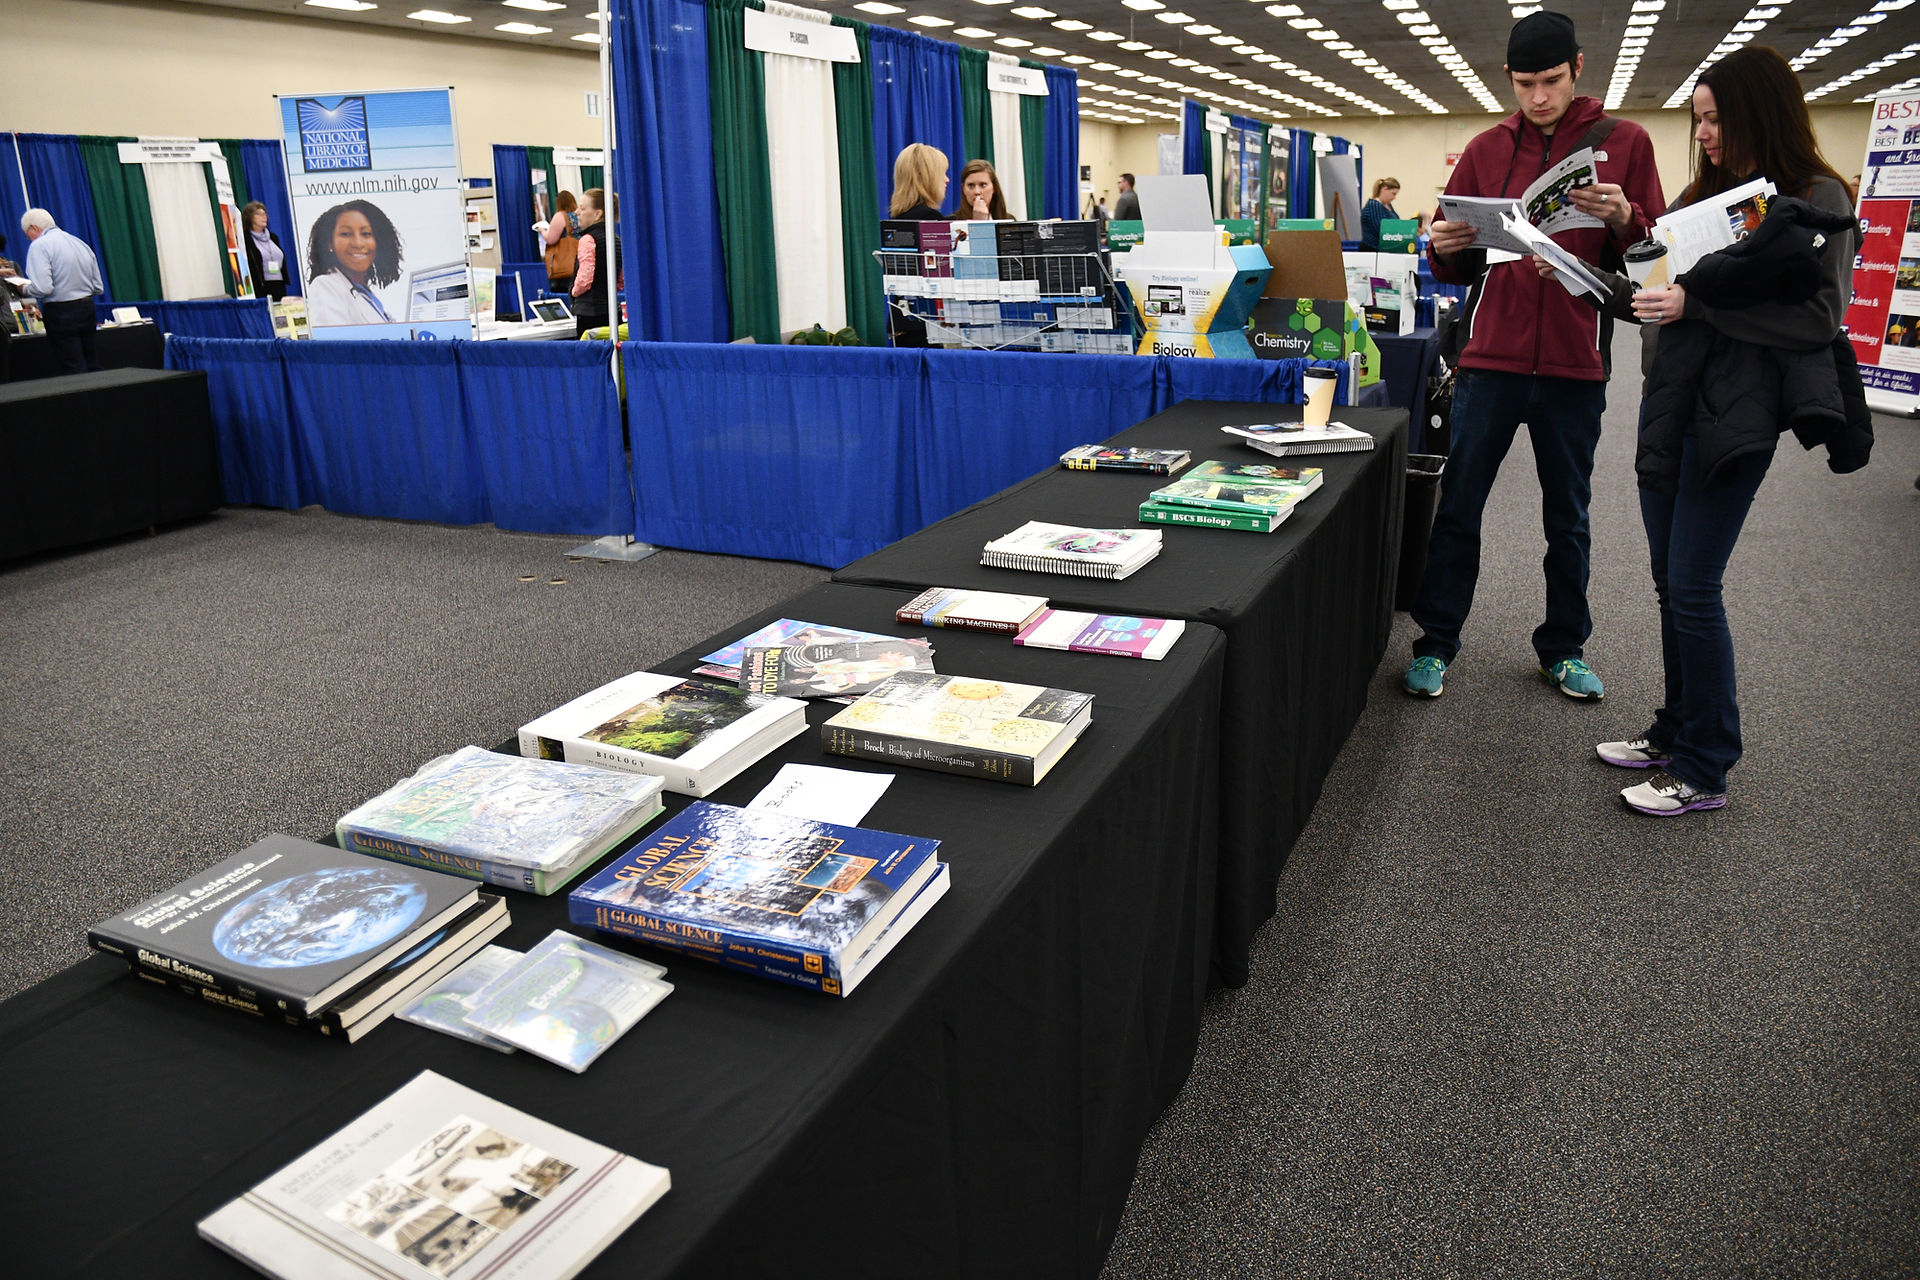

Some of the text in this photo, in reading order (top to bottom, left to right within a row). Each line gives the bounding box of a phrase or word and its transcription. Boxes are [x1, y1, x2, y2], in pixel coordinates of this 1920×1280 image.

[586, 94, 599, 116] H
[306, 131, 363, 144] NATIONAL
[1874, 138, 1896, 147] BEST
[305, 144, 366, 157] LIBRARY OF
[1885, 151, 1903, 163] and
[309, 157, 367, 170] MEDICINE
[305, 174, 439, 195] www.nlm.nih.gov
[1860, 219, 1891, 236] Boosting
[1853, 255, 1897, 273] Engineering,
[1188, 288, 1211, 296] realize
[1153, 342, 1197, 358] Biology
[1254, 332, 1311, 353] Chemistry
[1172, 513, 1195, 522] BSCS
[1197, 514, 1232, 527] Biology
[923, 615, 964, 626] THINKING
[966, 619, 1008, 629] MACHINES
[763, 666, 778, 682] DYE
[762, 682, 778, 694] TO
[596, 751, 645, 768] BIOLOGY
[864, 740, 975, 768] Brock Biology of Microorganisms
[353, 832, 483, 872] GLOBAL SCIENCE
[614, 835, 691, 881] GLOBAL
[644, 837, 720, 889] SCIENCE
[134, 862, 255, 926] Global Science
[160, 879, 263, 934] John W. Christensen
[611, 910, 663, 931] GLOBAL
[665, 922, 723, 944] SCIENCE
[729, 944, 747, 953] John
[757, 948, 800, 963] Christensen
[138, 949, 171, 971] Global
[172, 960, 214, 984] Science
[764, 965, 817, 985] Teacher's Guide
[202, 988, 226, 1000] Global
[228, 993, 259, 1011] Science
